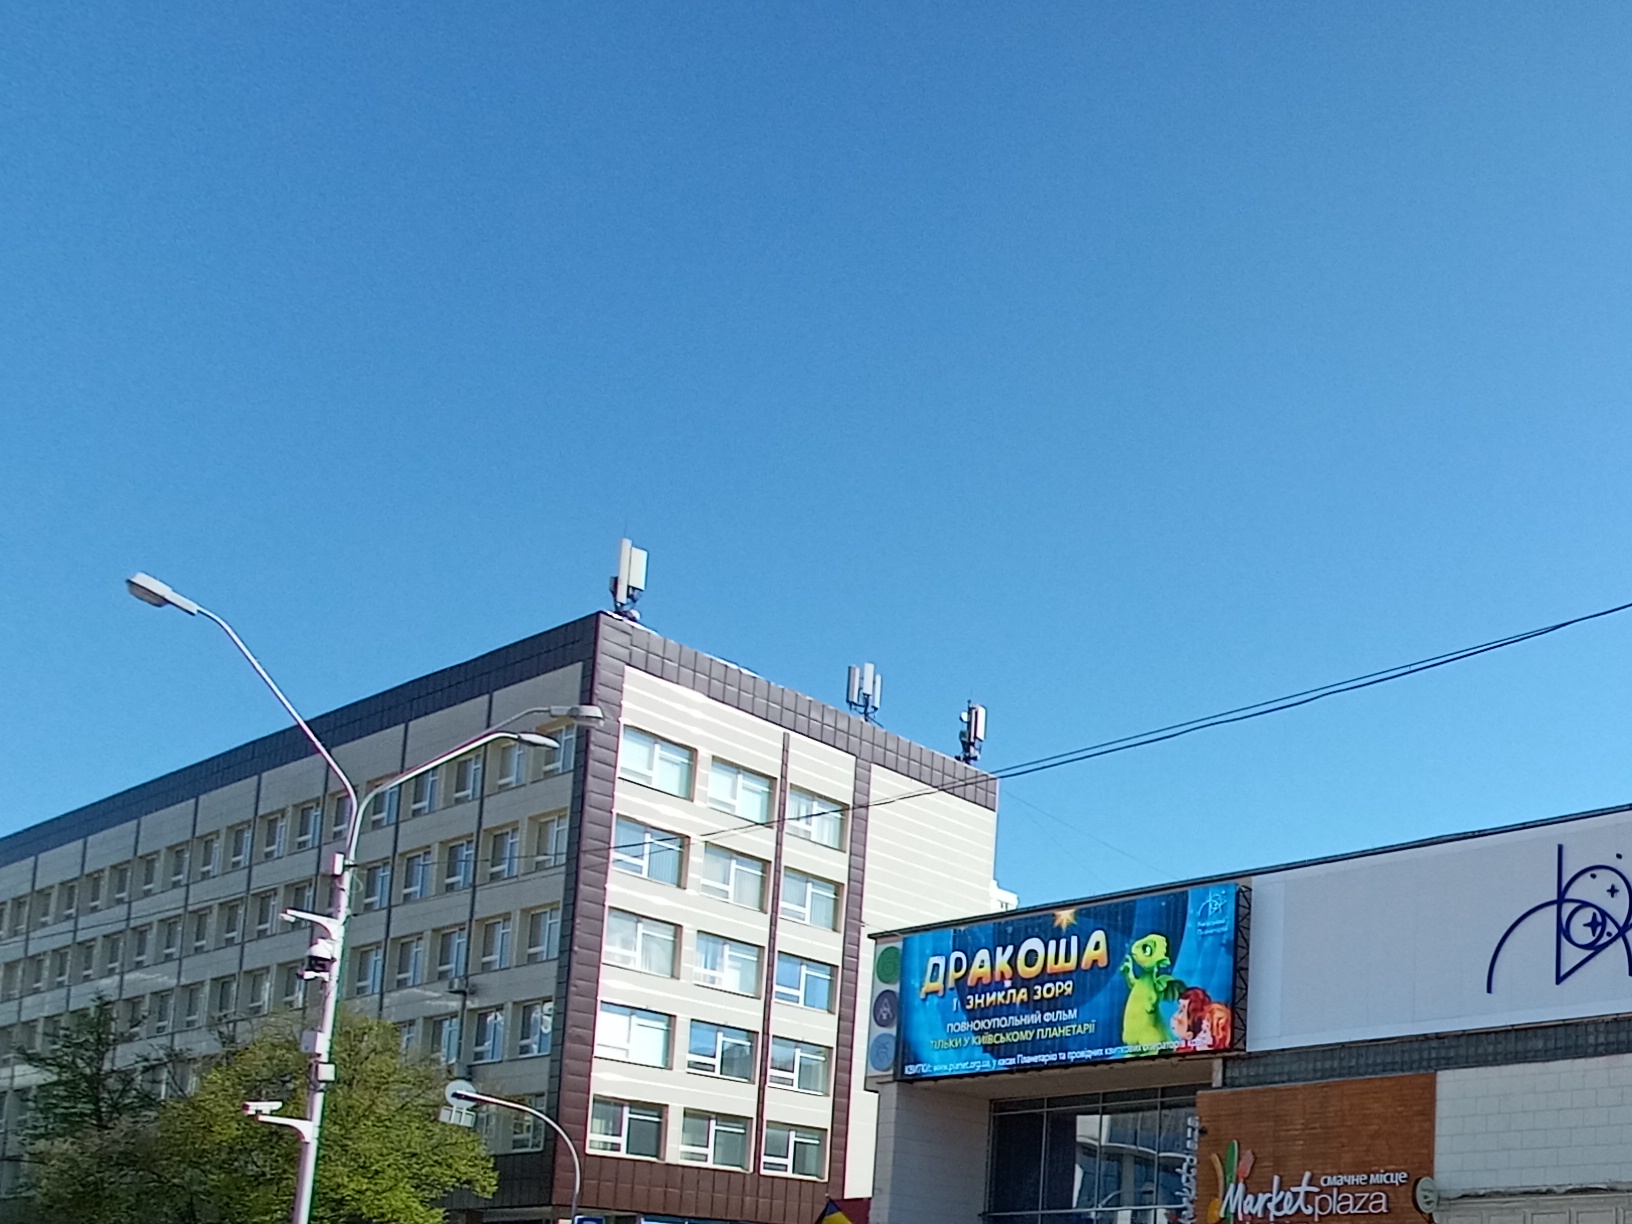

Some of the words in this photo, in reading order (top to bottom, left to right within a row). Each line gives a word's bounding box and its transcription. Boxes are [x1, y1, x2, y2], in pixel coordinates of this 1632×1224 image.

[919, 929, 1109, 999] ДРАКОША
[965, 988, 1028, 1010] ЗНИКЛА
[1033, 980, 1074, 1000] ЗОРЯ
[930, 1037, 962, 1050] ТІЛЬКИ
[963, 1036, 971, 1047] У
[972, 1028, 1035, 1046] КИЇВСЬКОМУ
[1036, 1020, 1097, 1040] ПЛАНЕТАРІЇ
[946, 1011, 1042, 1034] ПОВНОКУПОЛЬНИЙ
[1042, 1008, 1078, 1023] ФІЛЬМ
[1320, 1173, 1369, 1188] смачне
[1370, 1169, 1409, 1187] місце
[1220, 1171, 1321, 1221] Market
[1313, 1189, 1388, 1221] plaza
